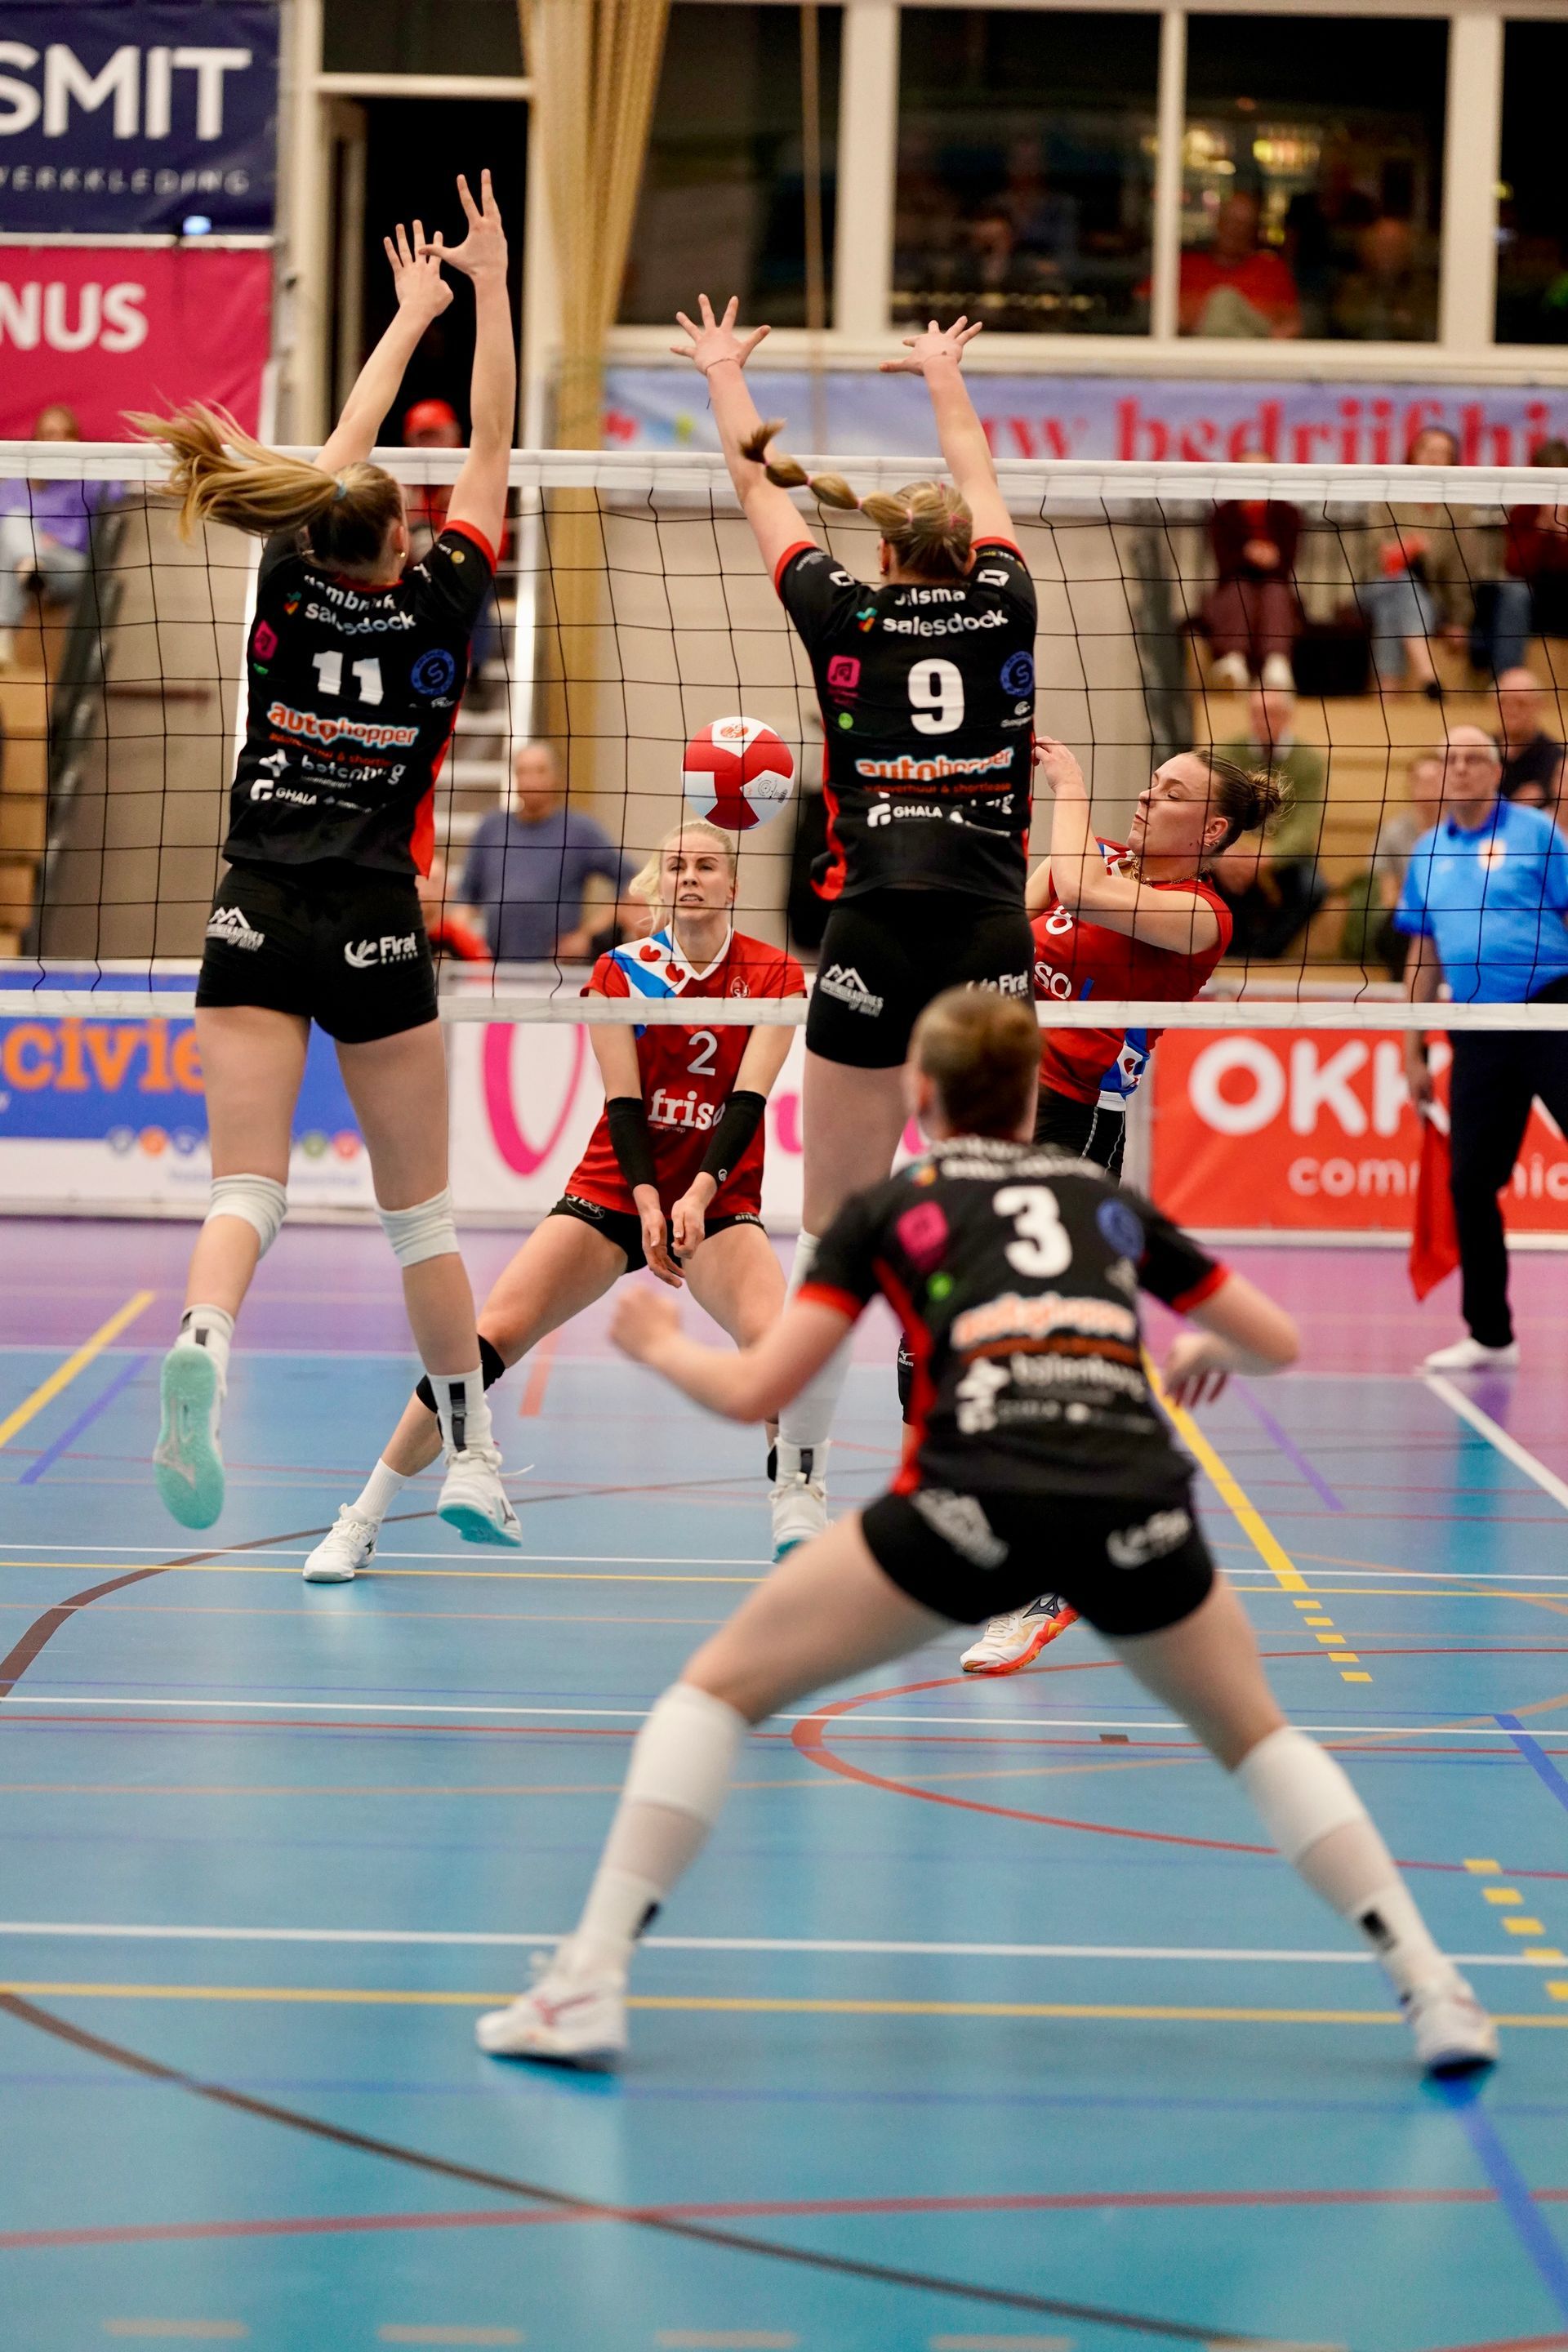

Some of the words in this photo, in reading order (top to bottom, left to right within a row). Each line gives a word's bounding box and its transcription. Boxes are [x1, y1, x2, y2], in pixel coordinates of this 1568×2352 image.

[0, 42, 252, 140] SMIT
[0, 282, 148, 353] NUS
[883, 610, 1009, 637] salesdock
[312, 650, 384, 706] 11
[908, 658, 964, 735] 9
[267, 701, 419, 749] autohopper
[275, 787, 317, 805] GHALA
[893, 804, 942, 819] GHALA
[687, 1031, 718, 1076] 2
[992, 1186, 1073, 1278] 3
